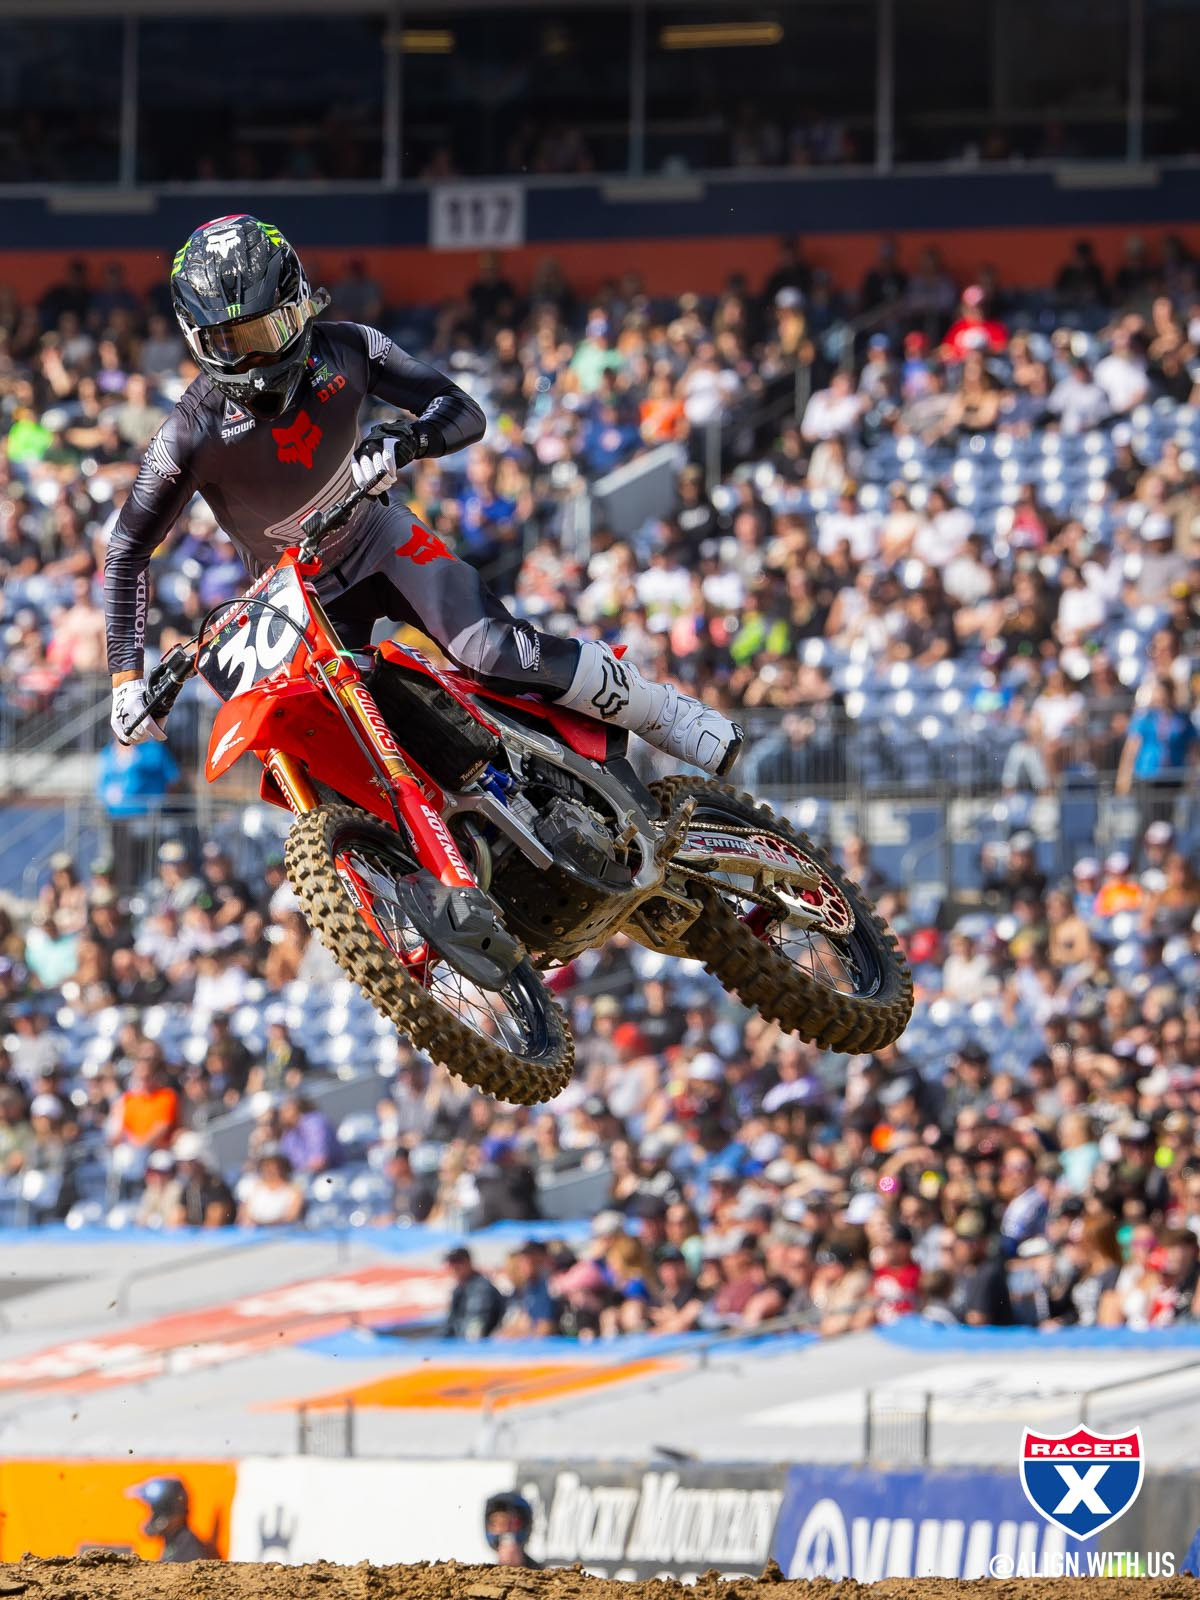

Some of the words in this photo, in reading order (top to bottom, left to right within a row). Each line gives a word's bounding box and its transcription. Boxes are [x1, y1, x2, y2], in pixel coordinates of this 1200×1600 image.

[448, 195, 515, 237] 117
[316, 375, 346, 403] DID
[221, 419, 256, 439] SHOWA
[134, 570, 148, 650] HONDA
[214, 571, 274, 629] RENHAL
[217, 586, 308, 701] 30
[532, 633, 541, 672] HONDA
[115, 686, 129, 725] FOX
[460, 769, 476, 783] Twin
[474, 760, 484, 772] Air
[419, 804, 473, 884] DUNLOP
